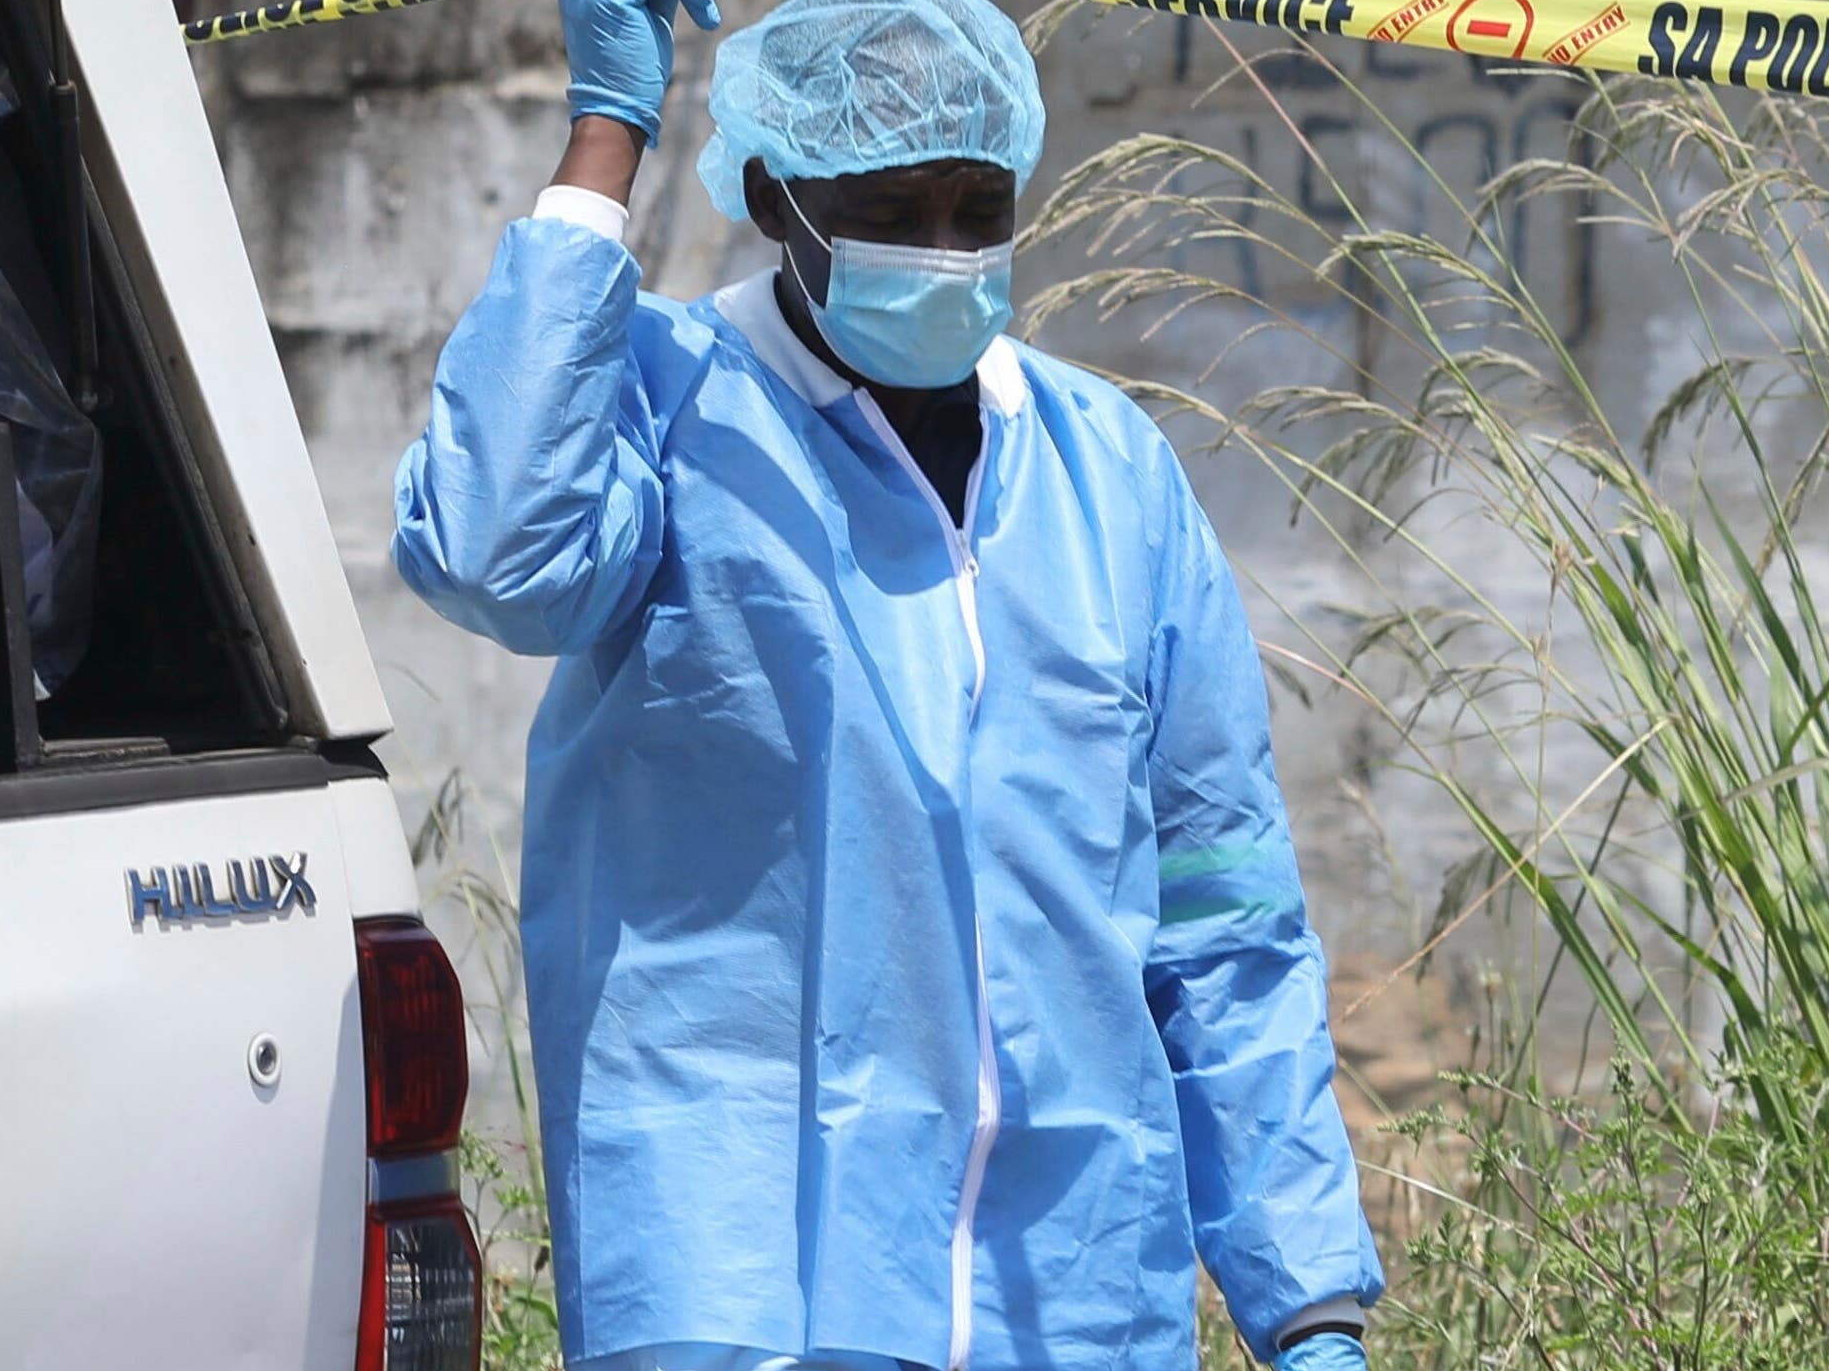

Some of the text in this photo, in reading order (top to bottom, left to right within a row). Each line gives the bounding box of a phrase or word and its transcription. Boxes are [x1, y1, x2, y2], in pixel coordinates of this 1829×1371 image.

[1571, 6, 1626, 51] ENTRY
[1638, 2, 1730, 81] SA
[124, 852, 316, 927] HILUX
